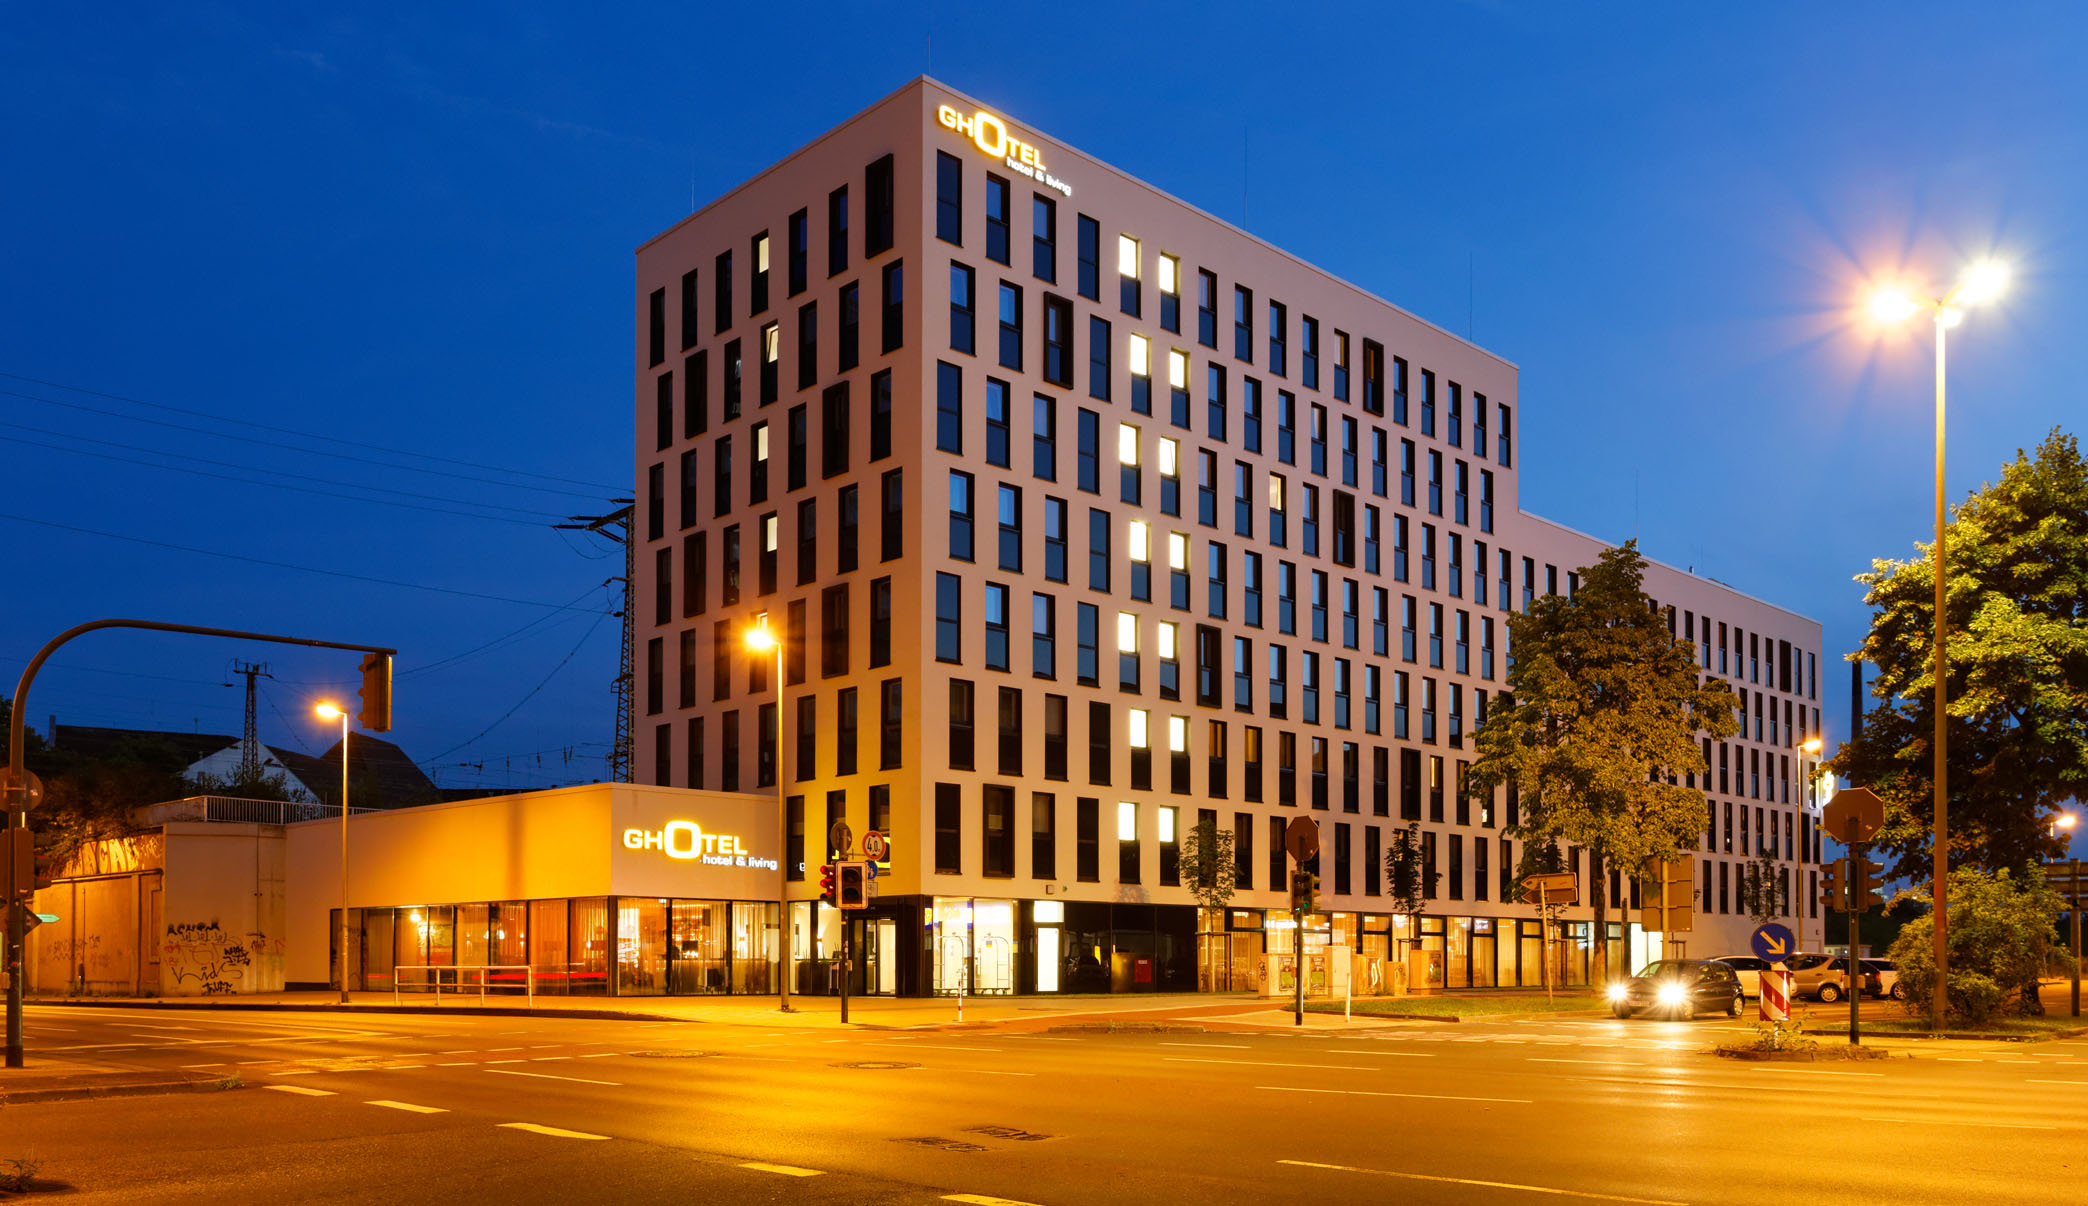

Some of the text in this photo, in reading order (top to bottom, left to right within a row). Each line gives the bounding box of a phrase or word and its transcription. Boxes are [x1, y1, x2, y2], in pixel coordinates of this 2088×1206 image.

[938, 104, 1047, 171] GHOTEL
[1006, 155, 1072, 197] hotel & living
[623, 820, 748, 859] GHOTEL
[702, 854, 778, 871] hotel & living
